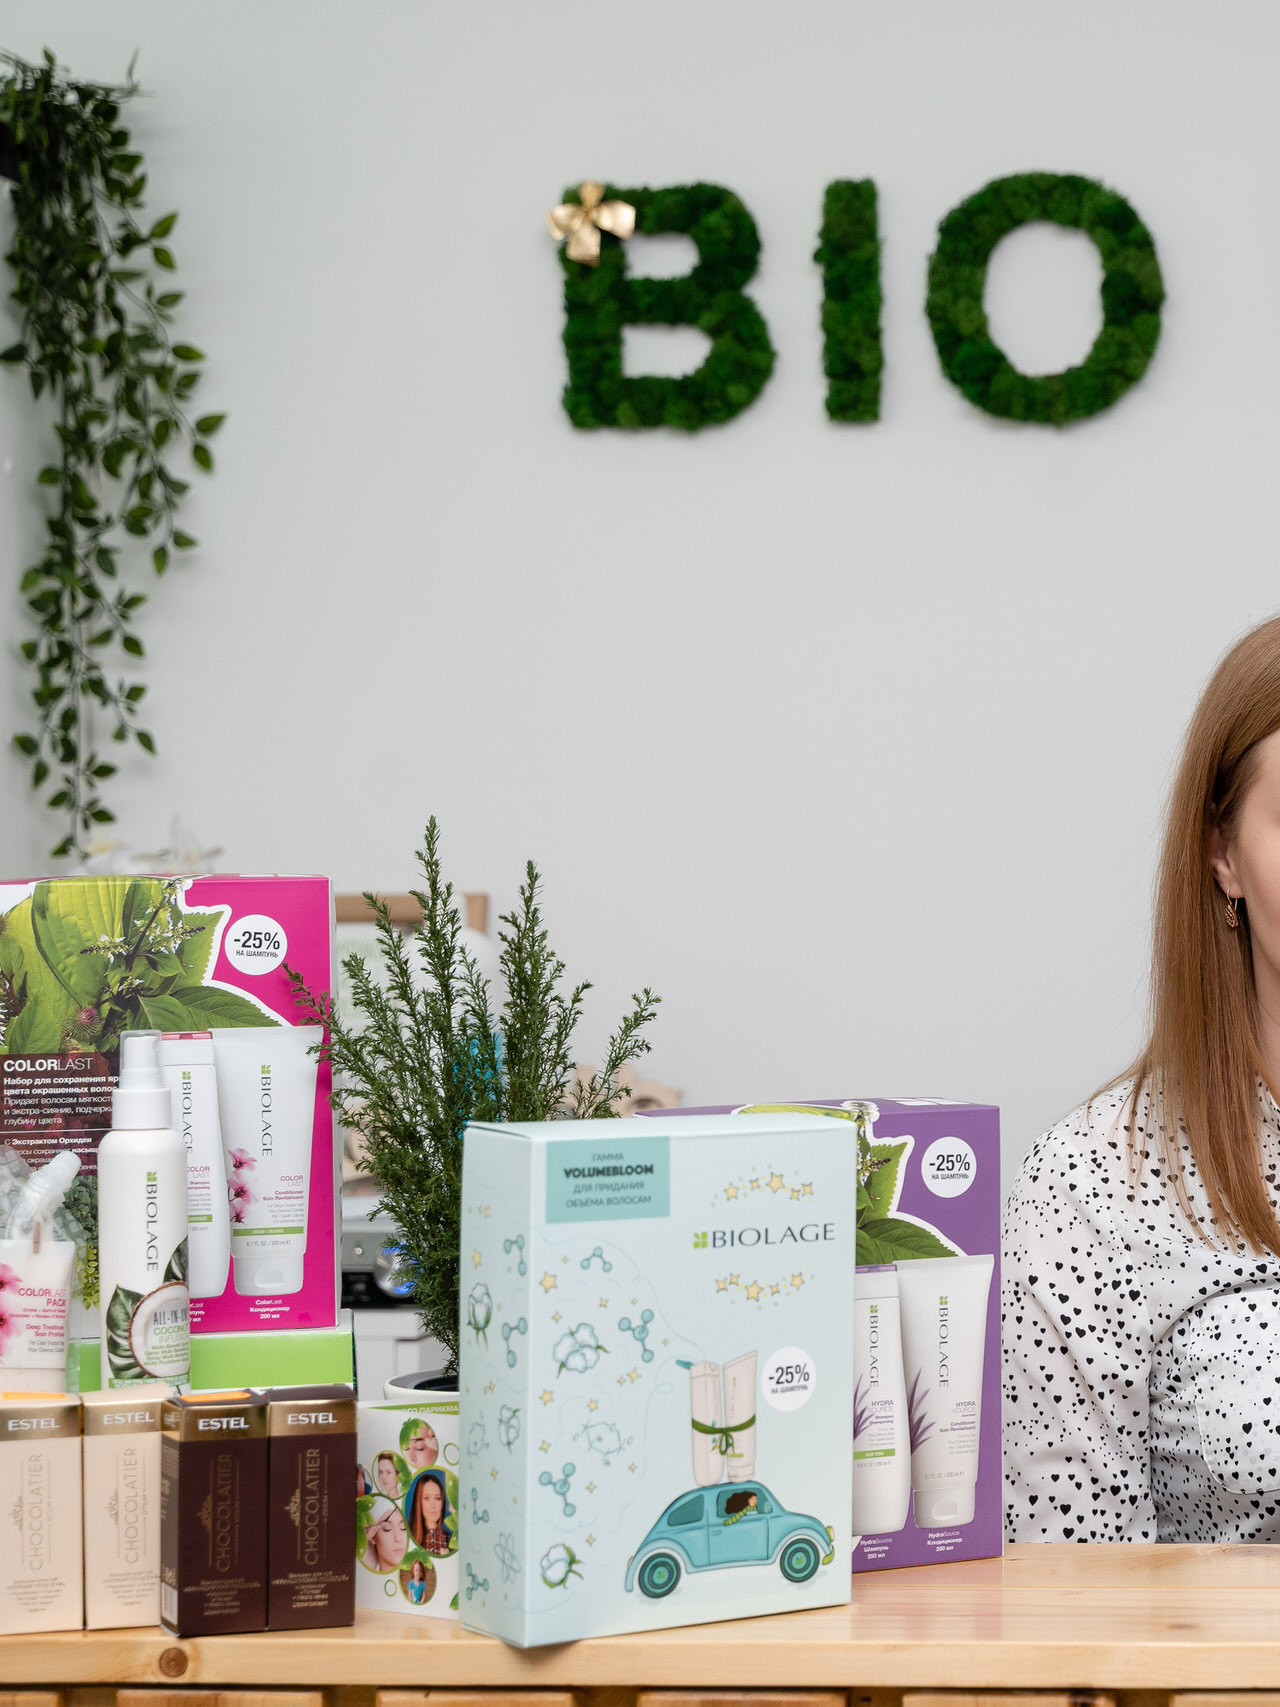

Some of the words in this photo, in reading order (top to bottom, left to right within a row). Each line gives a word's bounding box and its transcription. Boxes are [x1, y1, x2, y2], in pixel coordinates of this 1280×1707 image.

[560, 171, 1166, 434] BIO
[234, 931, 280, 950] -25%
[246, 950, 278, 958] ШАМПУНЬ
[3, 1058, 93, 1072] COLORLAST
[4, 1077, 33, 1086] Набор
[34, 1077, 52, 1086] для
[53, 1076, 106, 1086] сохранения
[108, 1076, 119, 1085] яр
[4, 1088, 30, 1096] цвета
[32, 1087, 89, 1096] окрашенных
[4, 1097, 39, 1106] Придает
[41, 1097, 77, 1105] волосам
[78, 1096, 112, 1104] мягкост
[4, 1118, 37, 1127] глубину
[38, 1117, 62, 1126] цвета
[260, 1076, 272, 1157] BIOLAGE
[12, 1138, 57, 1147] Экстрактом
[59, 1137, 92, 1145] Орхидеи
[592, 1153, 624, 1161] ГАММА
[929, 1153, 970, 1171] -25%
[564, 1164, 654, 1178] VOLUMEBLOOM
[573, 1184, 593, 1194] ДЛЯ
[595, 1181, 645, 1192] ПРИДАНИЯ
[566, 1198, 604, 1208] ОБЪЕМА
[606, 1195, 651, 1206] ВОЛОСАМ
[146, 1184, 158, 1271] BIOLAGE
[712, 1223, 835, 1248] BIOLAGE
[869, 1315, 879, 1388] BIOLAGE
[939, 1307, 949, 1388] BIOLAGE
[769, 1363, 810, 1384] -25%
[420, 1405, 459, 1414] ПАРИКМА
[8, 1418, 61, 1431] ESTEL
[103, 1412, 155, 1425] ESTEL
[198, 1417, 249, 1430] ESTEL
[288, 1412, 337, 1425] ESTEL
[29, 1454, 43, 1571] CHOCOLATIER
[124, 1448, 139, 1564] CHOCOLATIER
[216, 1454, 232, 1572] CHOCOLATIER
[305, 1449, 320, 1565] CHOCOLATIER
